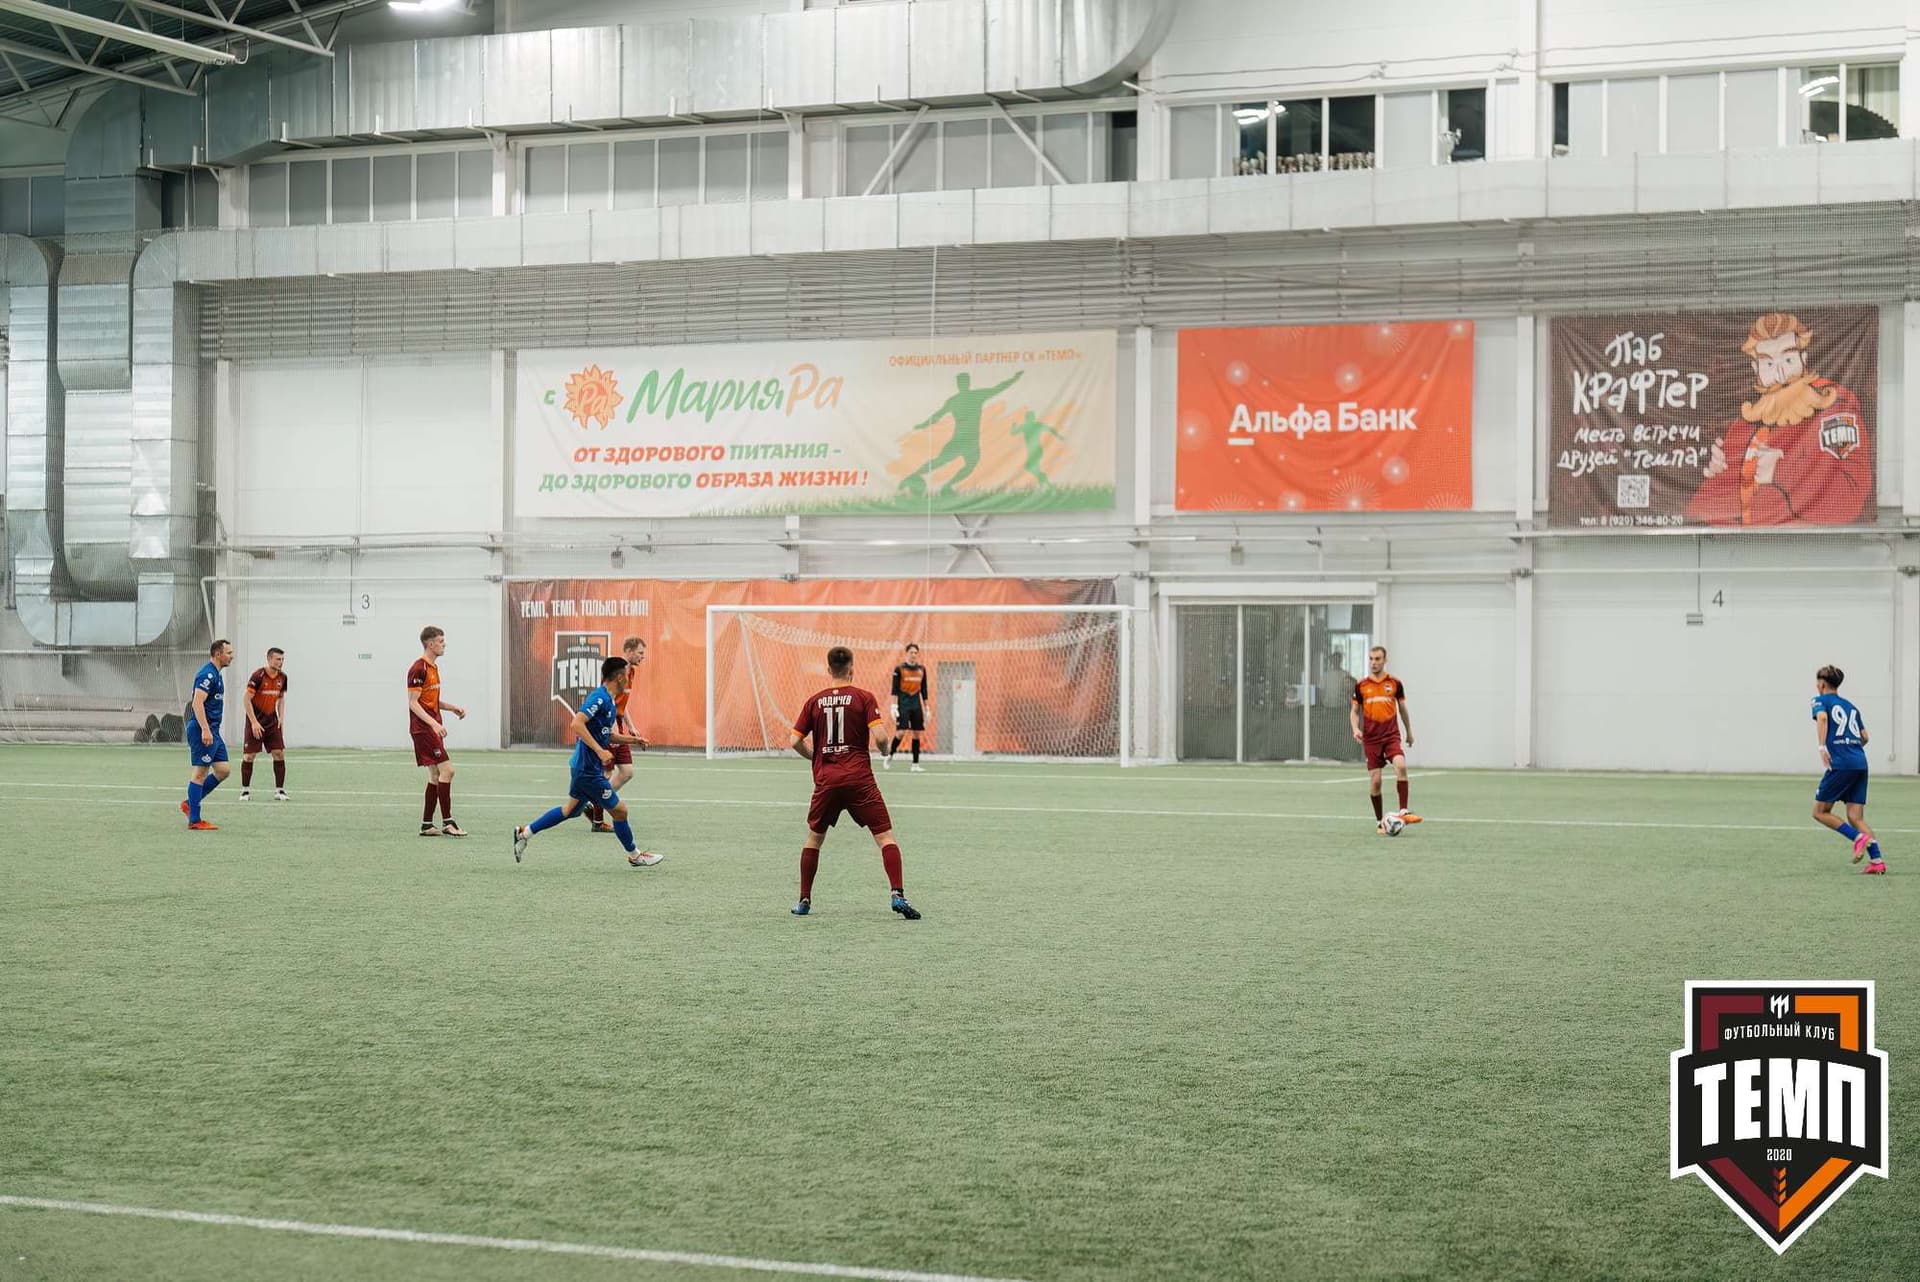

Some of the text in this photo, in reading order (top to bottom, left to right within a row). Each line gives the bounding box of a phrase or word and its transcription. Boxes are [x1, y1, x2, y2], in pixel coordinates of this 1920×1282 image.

[889, 352, 971, 368] ОФИЦИАЛЬНЫЙ
[1604, 331, 1665, 368] Паб
[1229, 402, 1417, 442] Альфа Банк
[574, 447, 600, 463] ОТ
[603, 445, 726, 465] ЗДОРОВОГО
[729, 443, 829, 461] ПИТАНИЯ
[539, 474, 569, 493] ДО
[571, 472, 692, 493] ЗДОРОВОГО
[695, 471, 774, 489] ОБРАЗА
[361, 593, 370, 609] 3
[521, 600, 649, 618] ТЕМП, ТЕМП, ТОЛЬКО ТЕМП!
[1712, 589, 1724, 608] 4
[818, 695, 852, 709] РОДИЧЕВ
[823, 706, 845, 745] 11
[1831, 704, 1862, 738] 96
